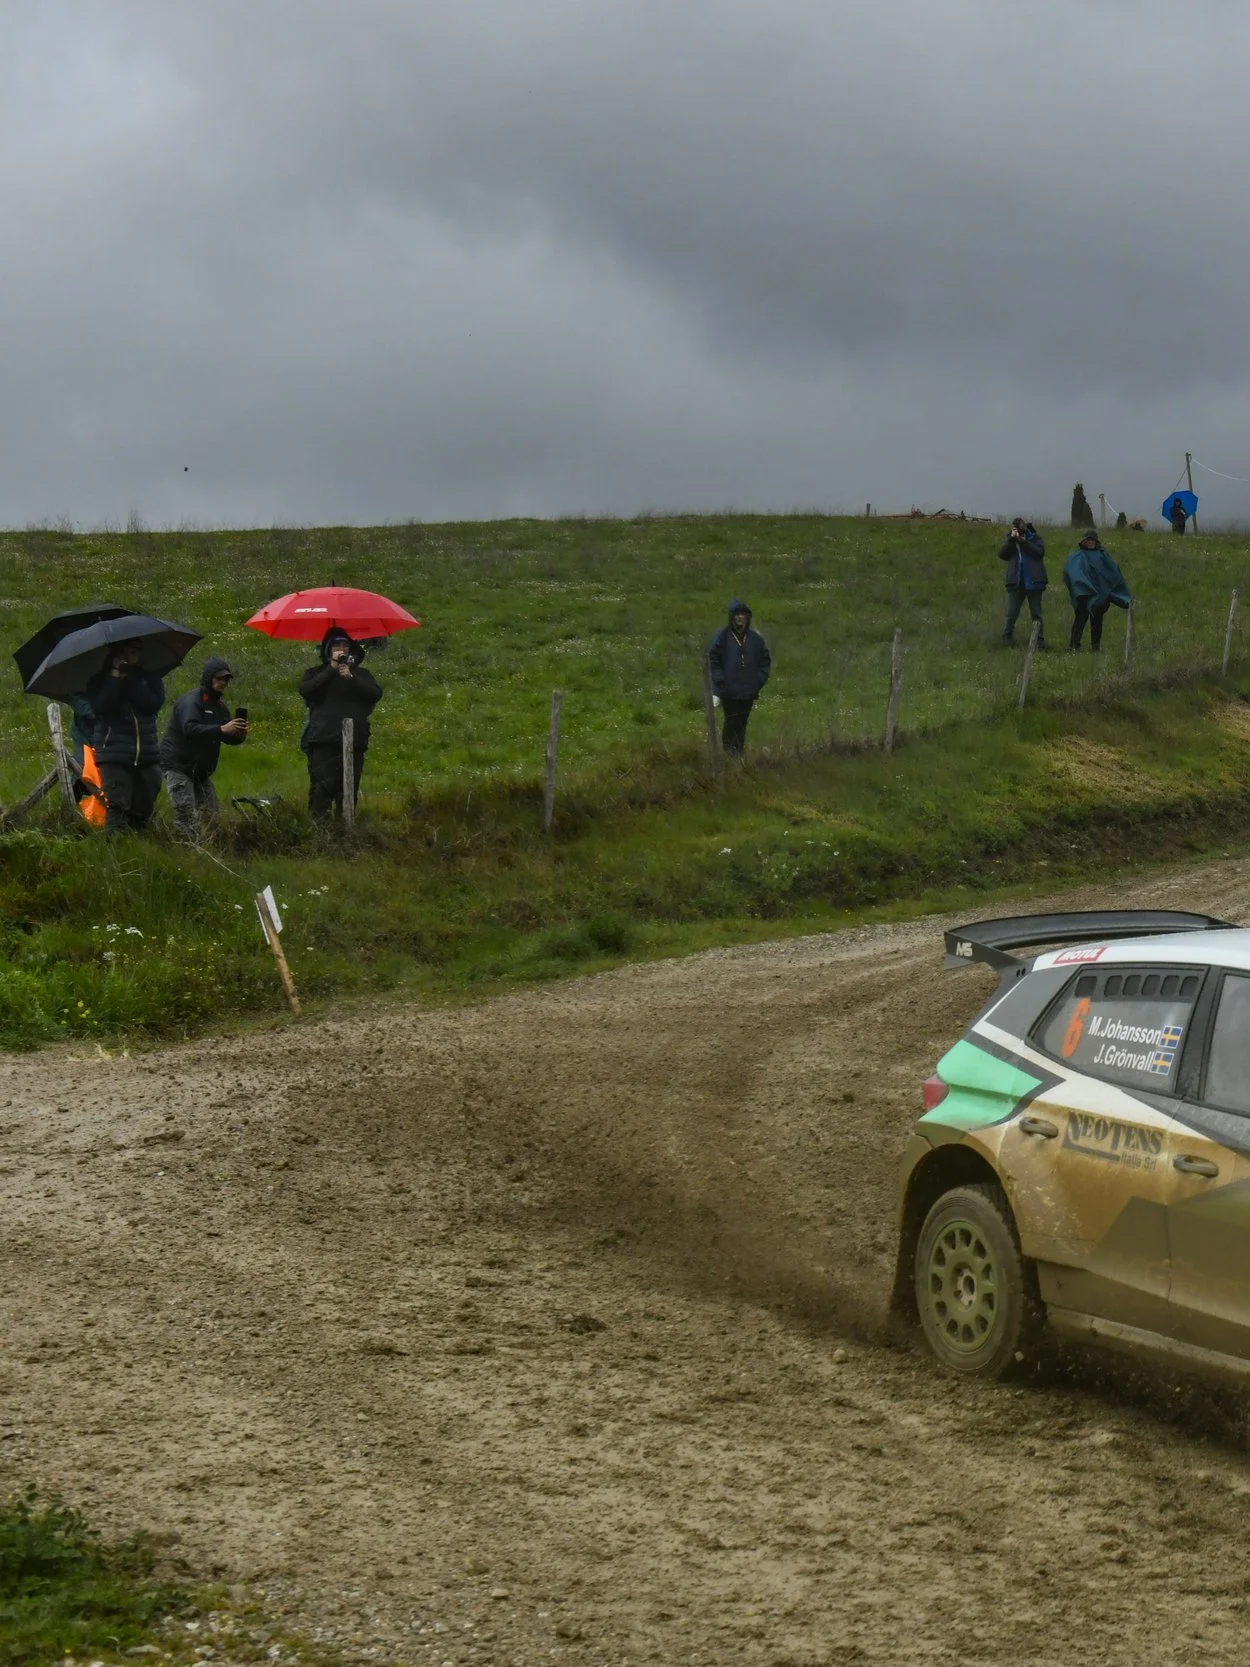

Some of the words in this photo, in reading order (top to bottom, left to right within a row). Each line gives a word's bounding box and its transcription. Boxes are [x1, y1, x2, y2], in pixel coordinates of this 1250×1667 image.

[1063, 997, 1091, 1059] 6
[1088, 1015, 1162, 1046] M.Johansson
[1094, 1044, 1154, 1072] J.Grönvall
